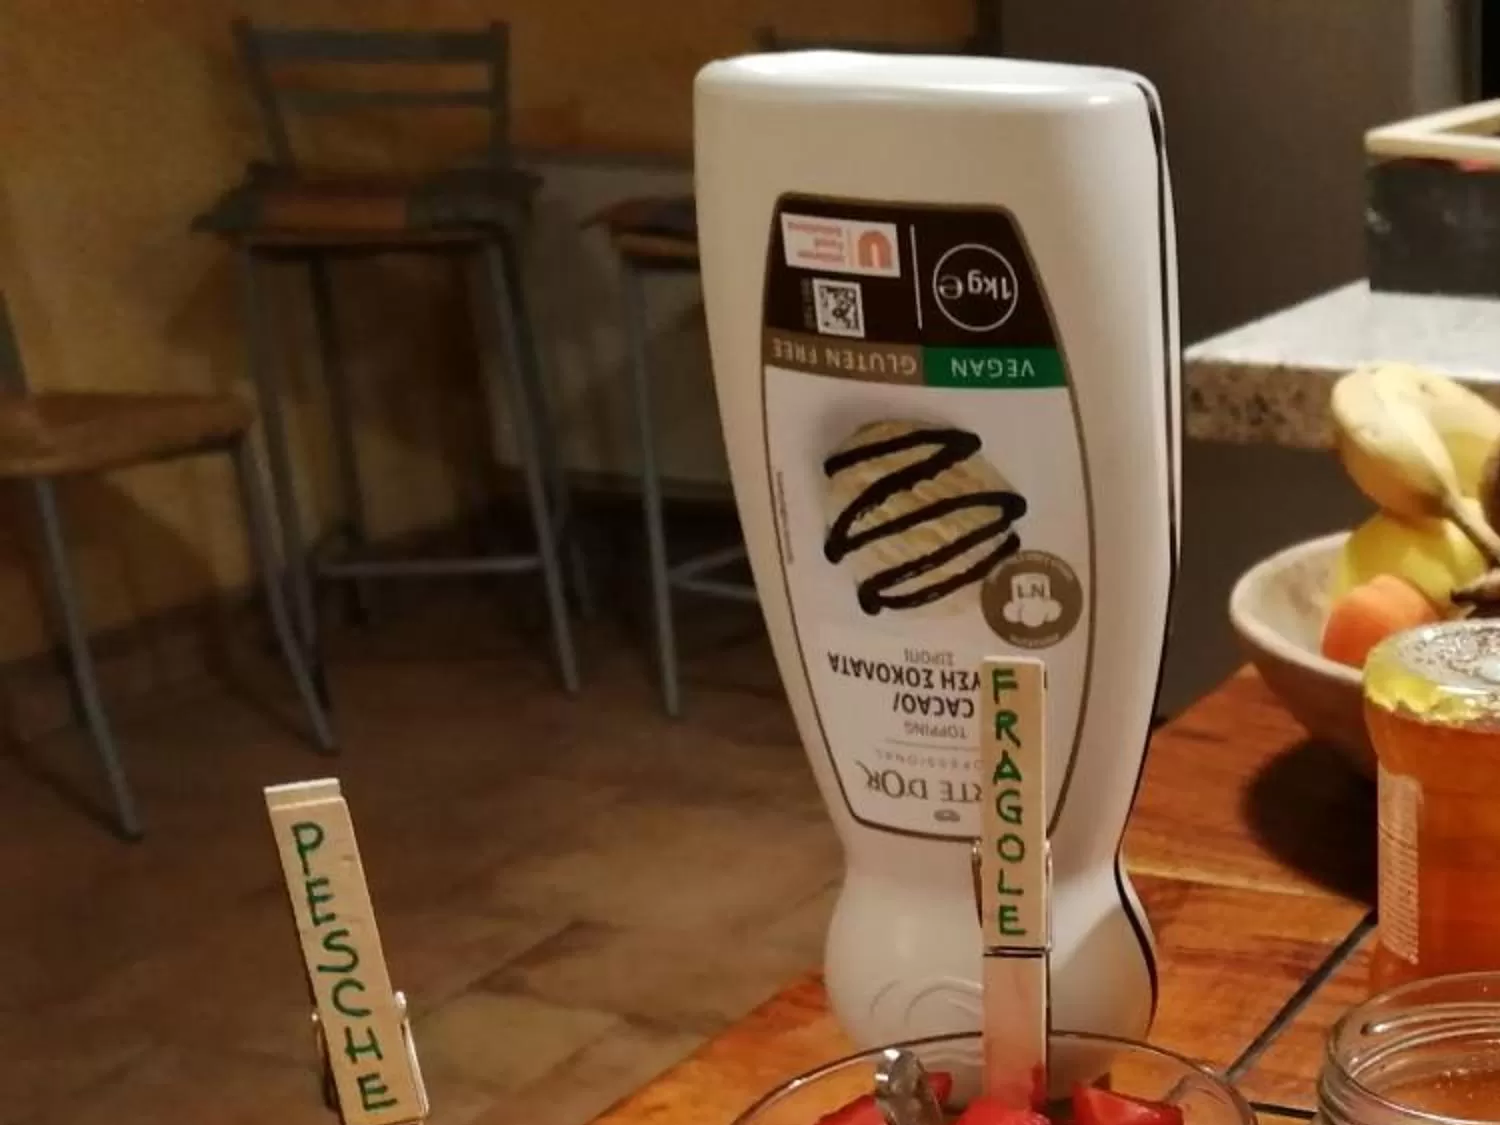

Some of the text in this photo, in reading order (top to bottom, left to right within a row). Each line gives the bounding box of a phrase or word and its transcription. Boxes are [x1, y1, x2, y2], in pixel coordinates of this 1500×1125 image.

[967, 269, 1012, 300] 1kg
[772, 337, 917, 376] GLUTEN FREE
[951, 357, 1035, 379] VEGAN
[904, 722, 967, 739] TOPPING
[992, 669, 1027, 936] FRAGOLE
[290, 822, 397, 1112] PESCHE
